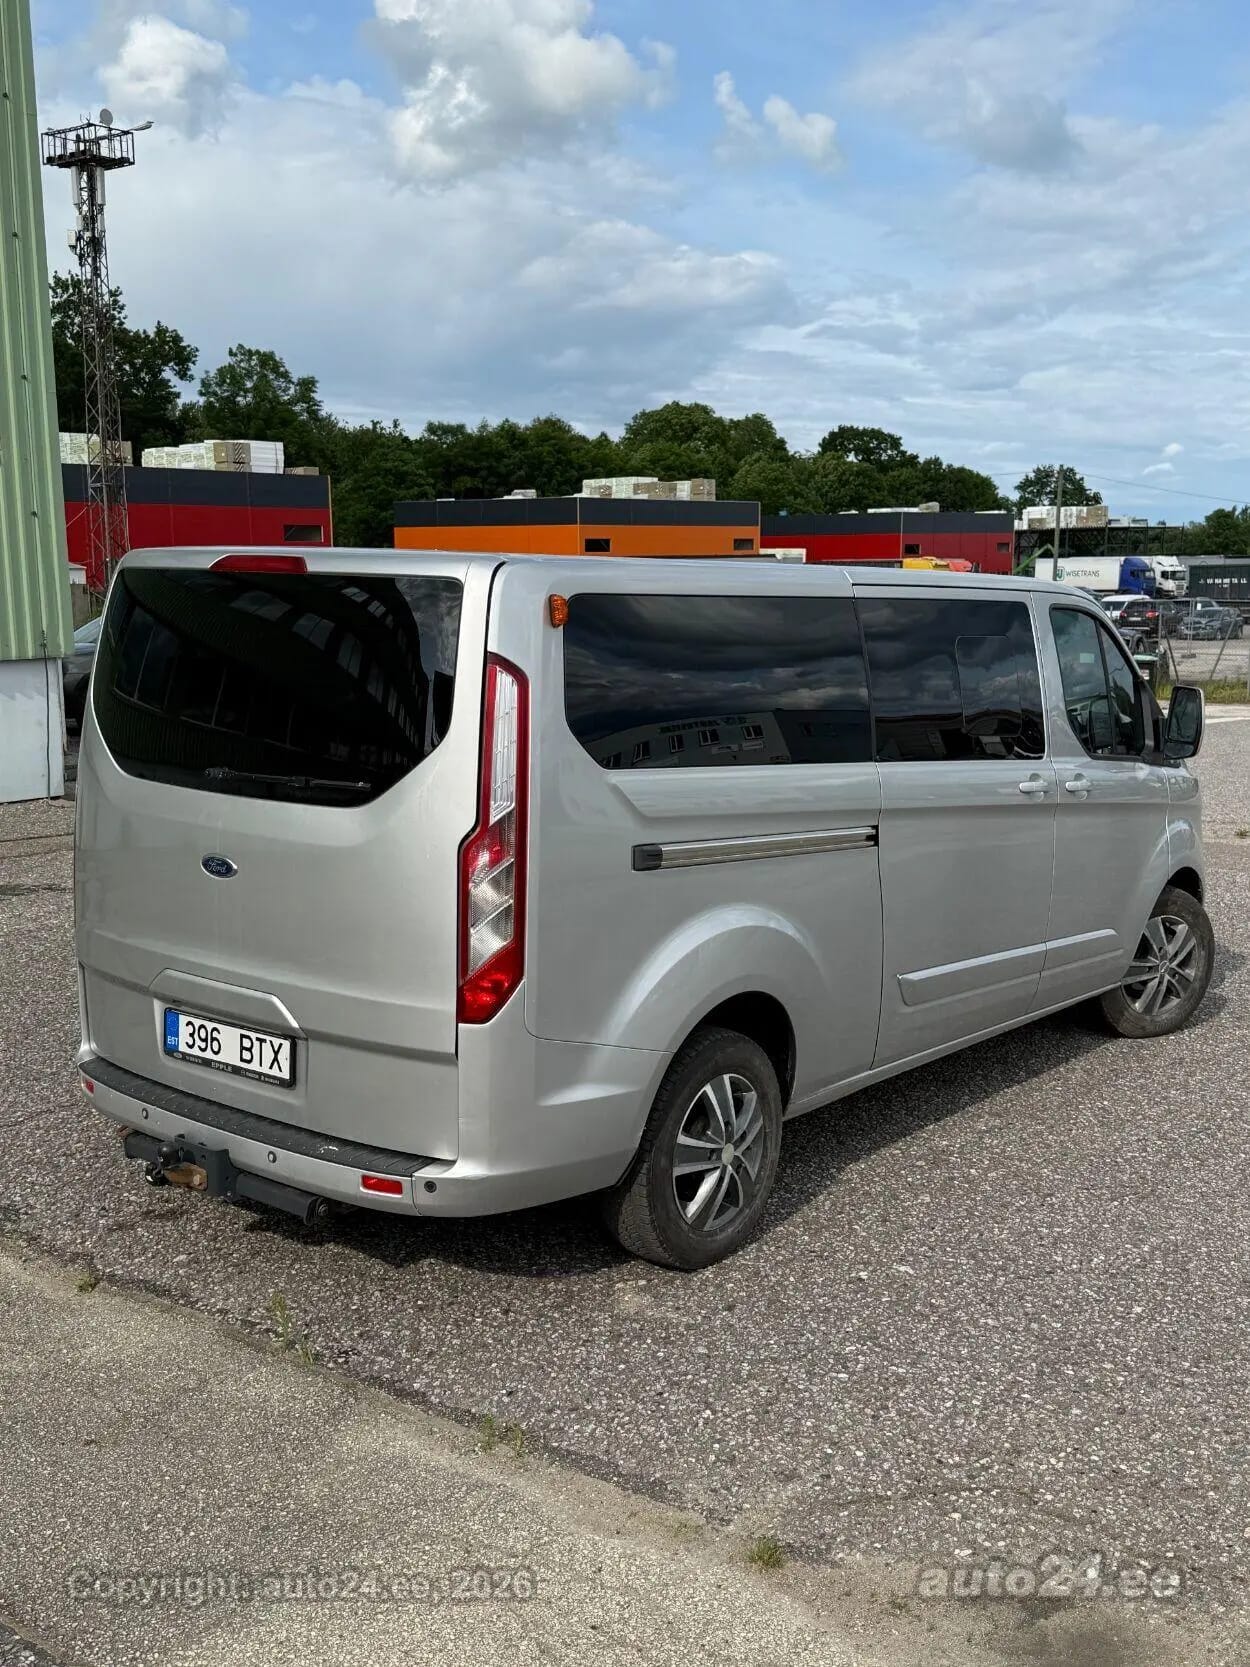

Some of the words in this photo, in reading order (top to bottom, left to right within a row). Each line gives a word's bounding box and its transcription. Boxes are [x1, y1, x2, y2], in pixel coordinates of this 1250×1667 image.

[1065, 569, 1100, 577] WISETRANS
[167, 1035, 178, 1046] EST
[185, 1020, 221, 1056] 396
[239, 1032, 283, 1073] BTX
[211, 1061, 233, 1073] EPPLE
